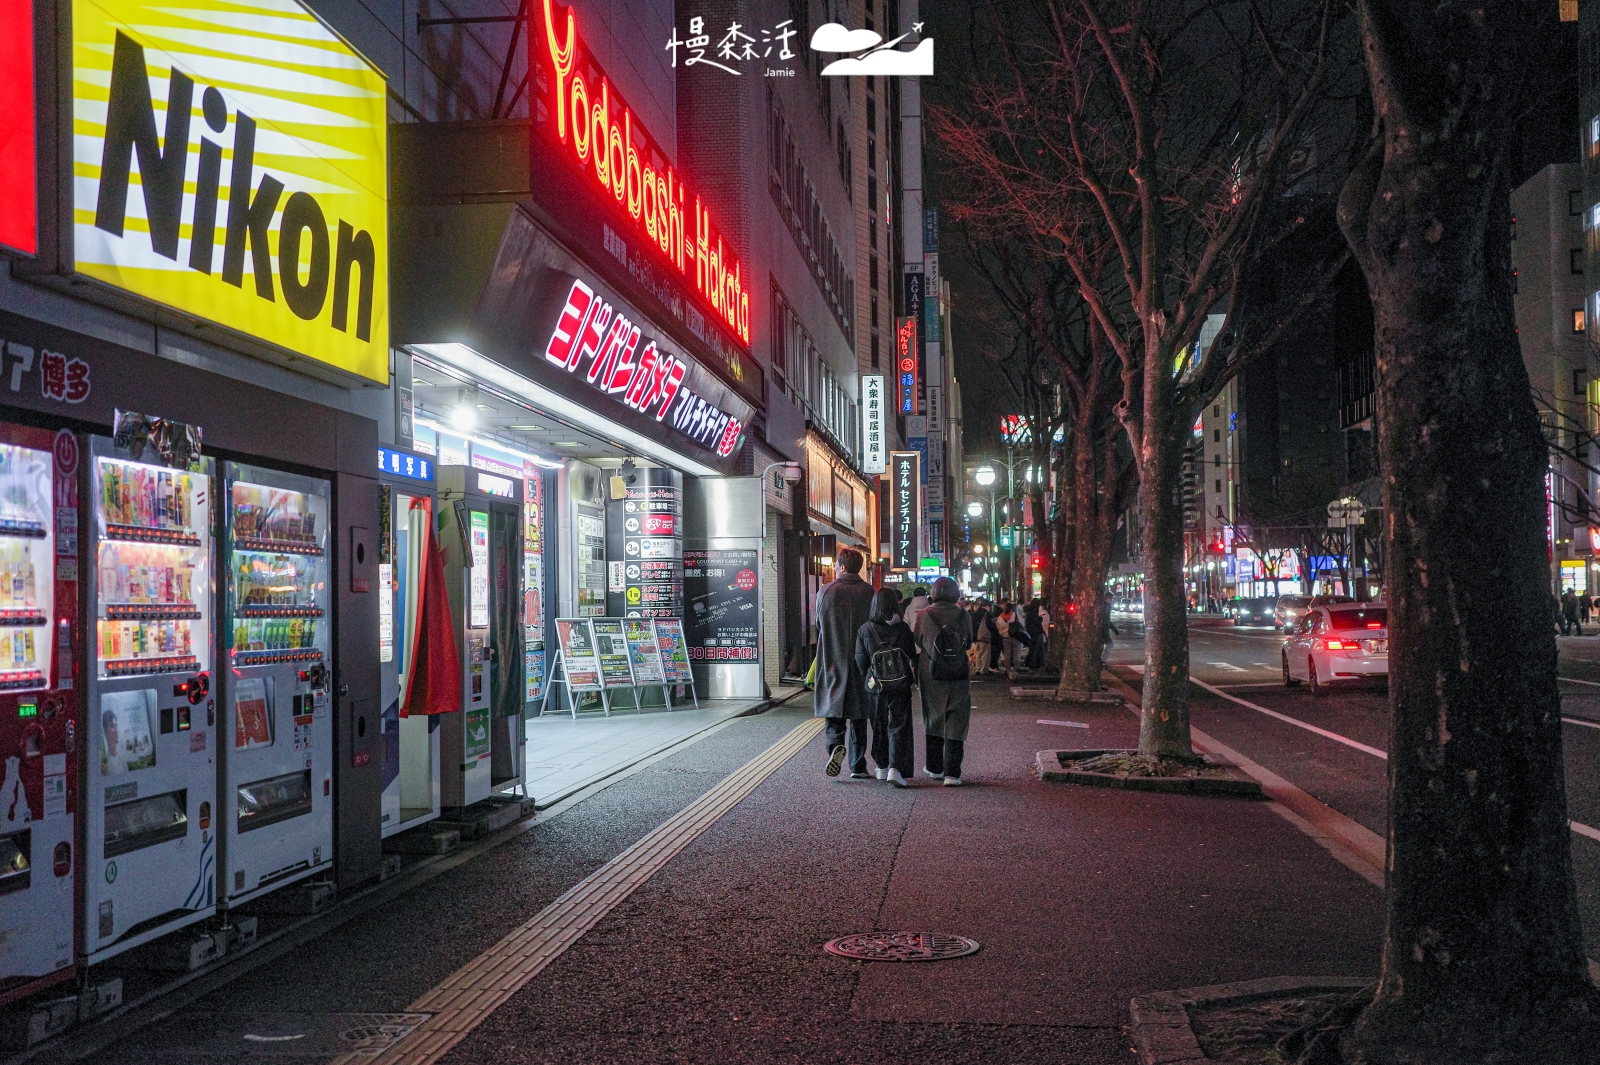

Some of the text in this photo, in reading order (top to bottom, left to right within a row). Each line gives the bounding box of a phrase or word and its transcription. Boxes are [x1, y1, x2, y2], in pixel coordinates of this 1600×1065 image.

[95, 28, 375, 343] Nikon
[545, 279, 687, 422] ヨドバシカメラ
[673, 386, 729, 448] マルチメディア
[716, 415, 742, 458] 博多
[41, 349, 91, 404] 博多
[869, 378, 879, 452] 大衆寿司居酒屋
[900, 460, 910, 566] ホテル センチュリーアート
[627, 543, 638, 552] 3階
[628, 567, 639, 575] 2階
[642, 570, 661, 579] テレビ
[629, 590, 639, 598] 1階
[739, 602, 754, 611] VISA
[641, 609, 672, 617] パソコン
[687, 646, 758, 660] 90日間補償!
